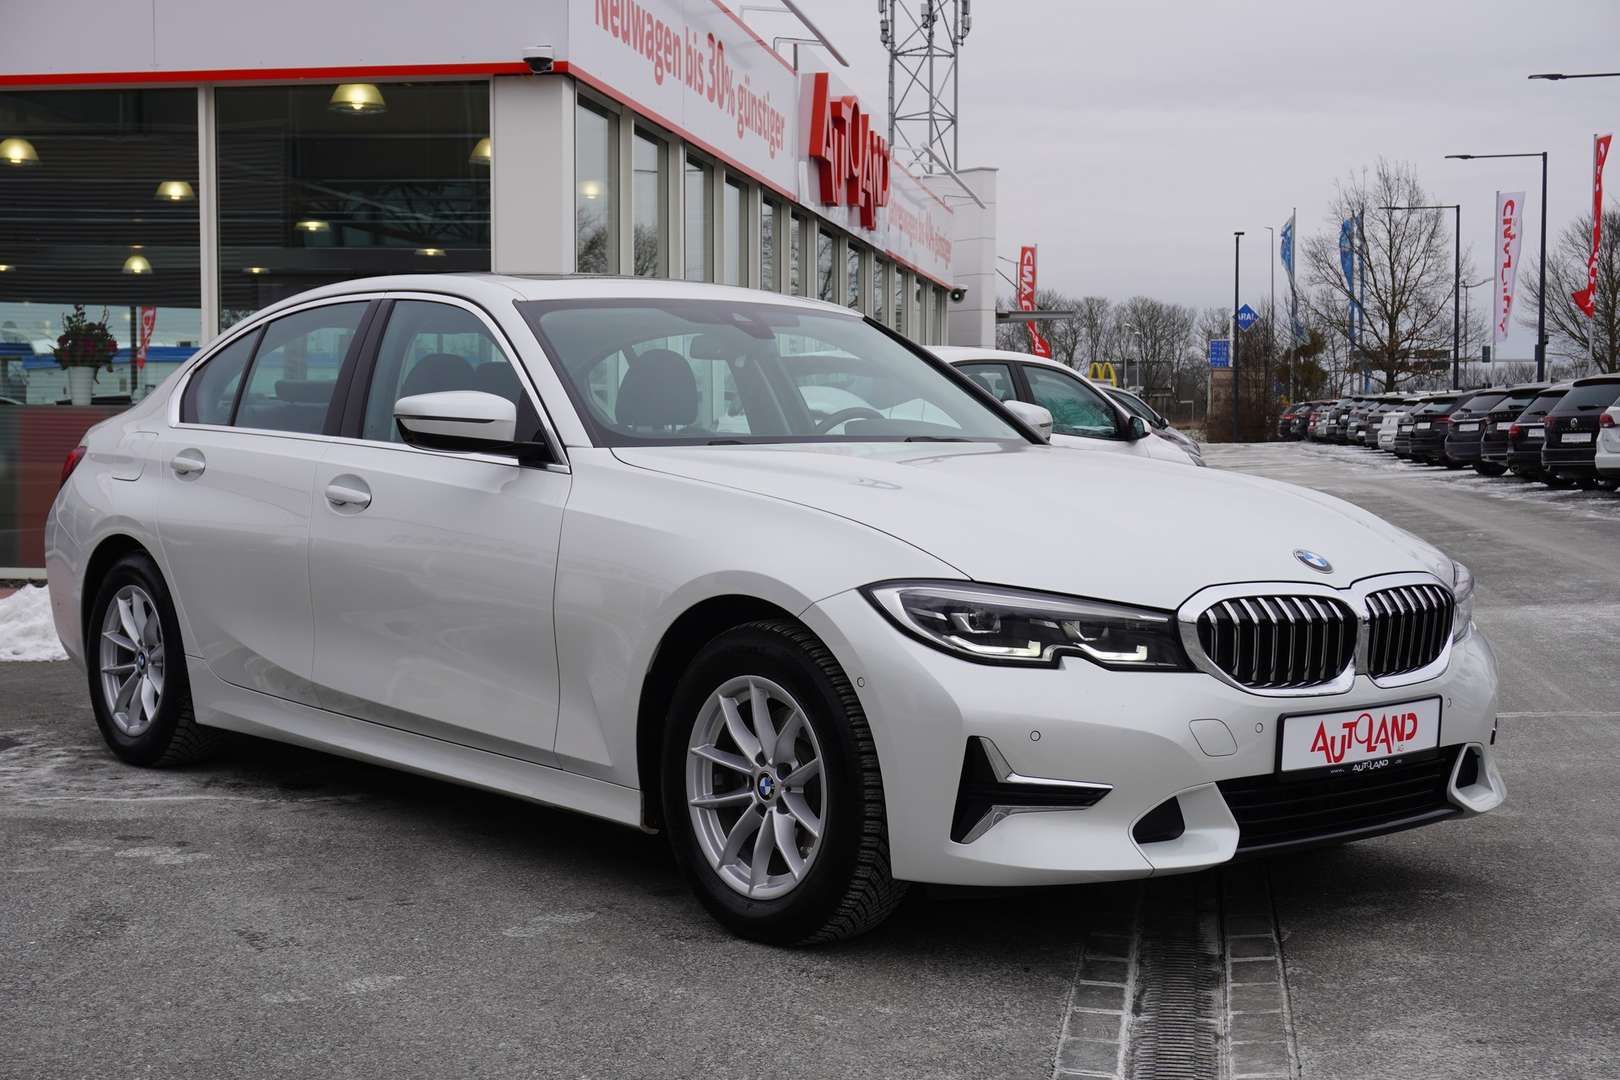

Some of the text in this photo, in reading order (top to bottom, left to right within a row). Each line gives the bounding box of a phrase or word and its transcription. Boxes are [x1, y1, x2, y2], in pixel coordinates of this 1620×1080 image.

[685, 26, 704, 96] bis
[706, 32, 735, 116] 30%
[736, 74, 785, 160] günstiger
[1311, 713, 1418, 764] AUTOLAND
[1352, 759, 1389, 772] AUTOLAND
